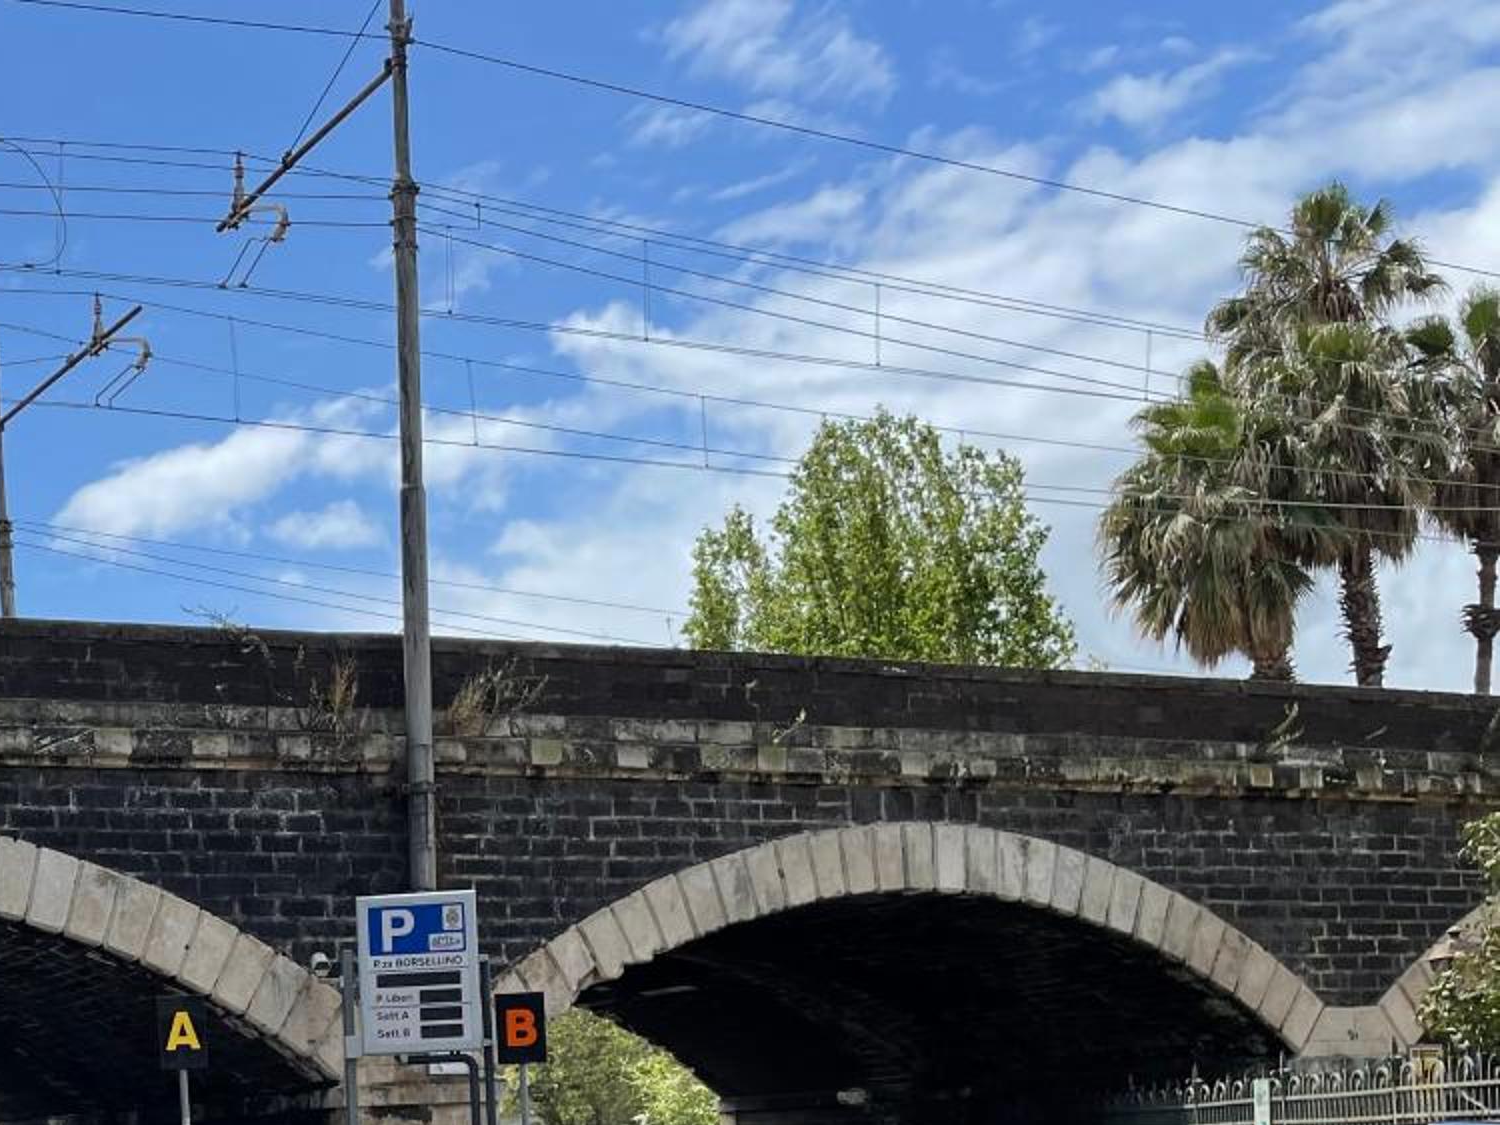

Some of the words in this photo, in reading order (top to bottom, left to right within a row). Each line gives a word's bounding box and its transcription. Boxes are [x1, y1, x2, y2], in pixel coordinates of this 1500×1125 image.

[381, 908, 415, 952] P
[395, 955, 463, 967] BORSELLINO
[165, 1011, 202, 1051] A
[504, 1008, 538, 1047] B
